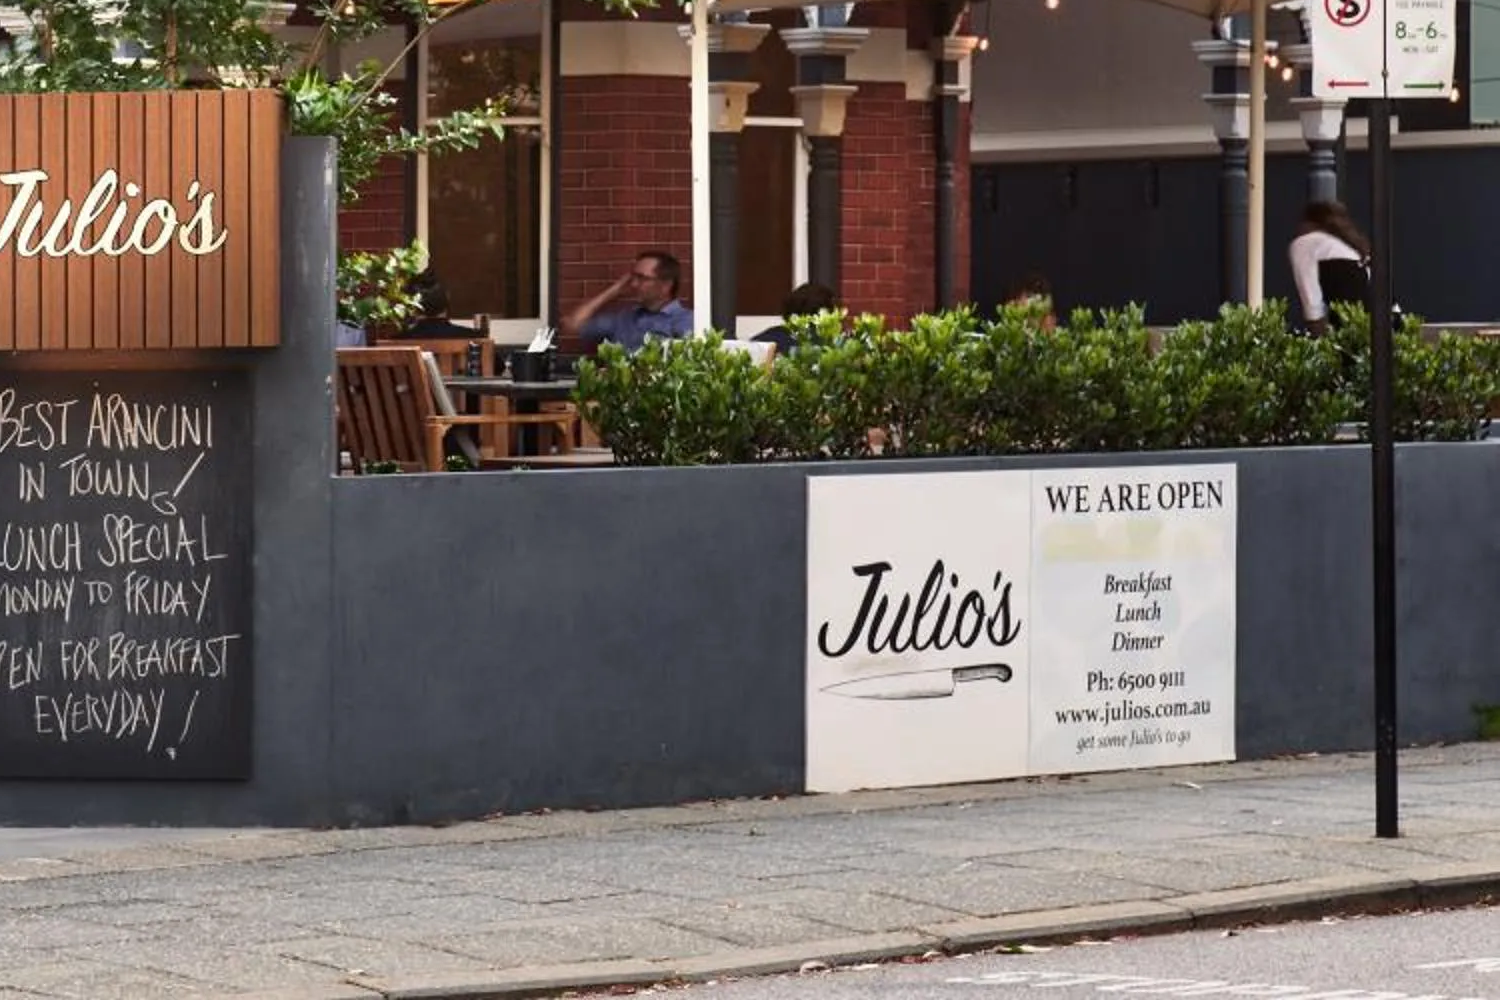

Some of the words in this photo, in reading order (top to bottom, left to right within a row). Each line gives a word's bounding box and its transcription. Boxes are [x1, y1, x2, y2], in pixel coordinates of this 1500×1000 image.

[87, 392, 212, 451] ARANCINI
[19, 461, 45, 502] IN
[1045, 485, 1091, 513] WE
[1097, 483, 1151, 512] ARE
[1157, 480, 1224, 511] OPEN
[98, 513, 229, 567] SPECIAL
[84, 580, 113, 605] TO
[124, 570, 211, 624] FRIDAY
[1104, 570, 1173, 599] Breakfast
[818, 559, 1022, 658] Julio's
[1114, 600, 1162, 623] Lunch
[60, 636, 100, 681] FOR
[107, 631, 242, 681] BREAKFAST
[1111, 631, 1165, 652] Dinner
[1087, 669, 1114, 692] Ph:
[1117, 671, 1156, 694] 6500
[1159, 671, 1185, 692] 9111
[1055, 699, 1211, 727] www.julios.com.au
[1165, 729, 1177, 743] to
